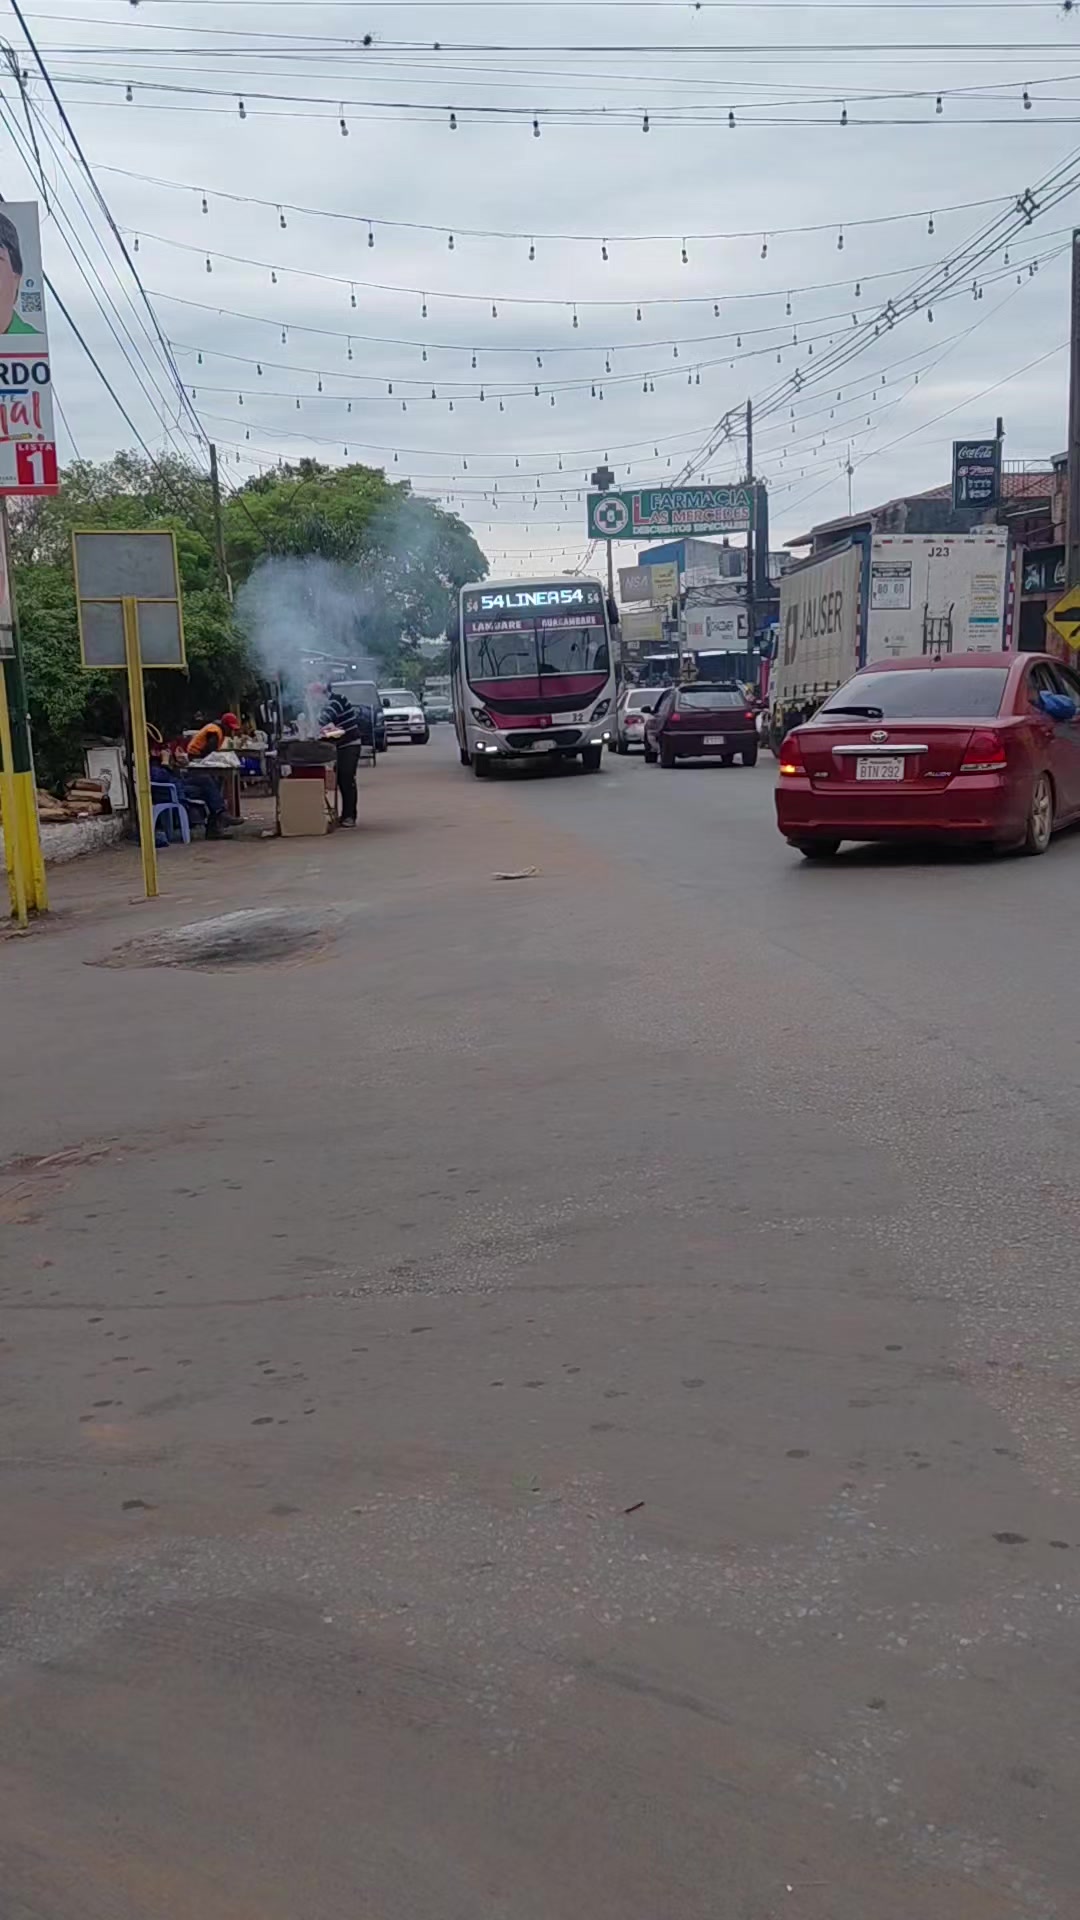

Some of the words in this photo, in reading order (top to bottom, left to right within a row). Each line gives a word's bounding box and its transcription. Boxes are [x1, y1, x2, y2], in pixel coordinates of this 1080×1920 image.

[18, 443, 53, 451] LISTA
[26, 450, 45, 484] 1
[651, 489, 750, 510] FARMACIA
[672, 507, 750, 523] MERCEDES
[928, 547, 950, 557] J23
[481, 595, 504, 609] 54
[560, 589, 583, 604] 54
[800, 590, 842, 640] JAUSER
[860, 765, 879, 778] BTN
[881, 765, 900, 778] 292
